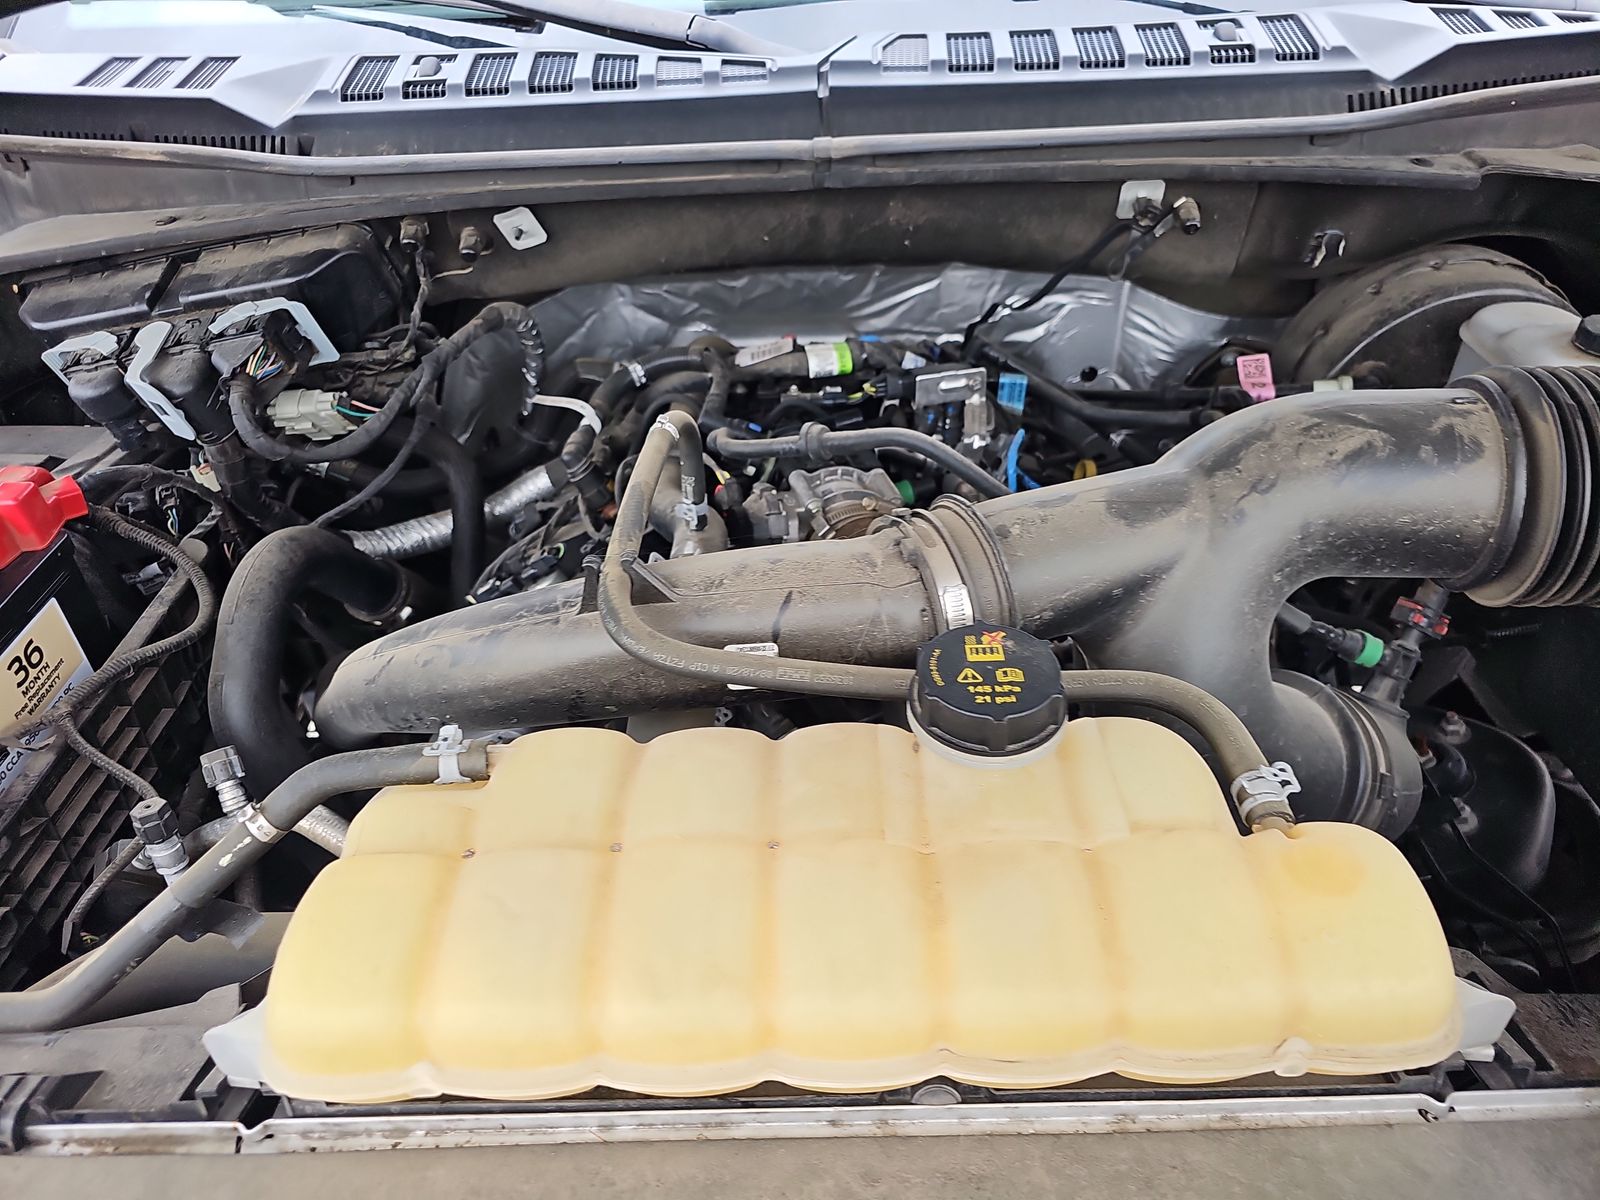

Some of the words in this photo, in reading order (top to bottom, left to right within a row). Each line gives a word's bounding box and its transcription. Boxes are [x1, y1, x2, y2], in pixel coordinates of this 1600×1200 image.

[7, 638, 44, 689] 36
[21, 662, 51, 698] MONTH
[14, 702, 29, 720] Free
[27, 658, 65, 703] Replacement
[27, 673, 61, 716] WARRANTY
[967, 685, 993, 693] 145
[994, 685, 1022, 693] kPa
[974, 695, 992, 703] 21
[995, 695, 1017, 704] psi
[6, 751, 24, 772] CCA
